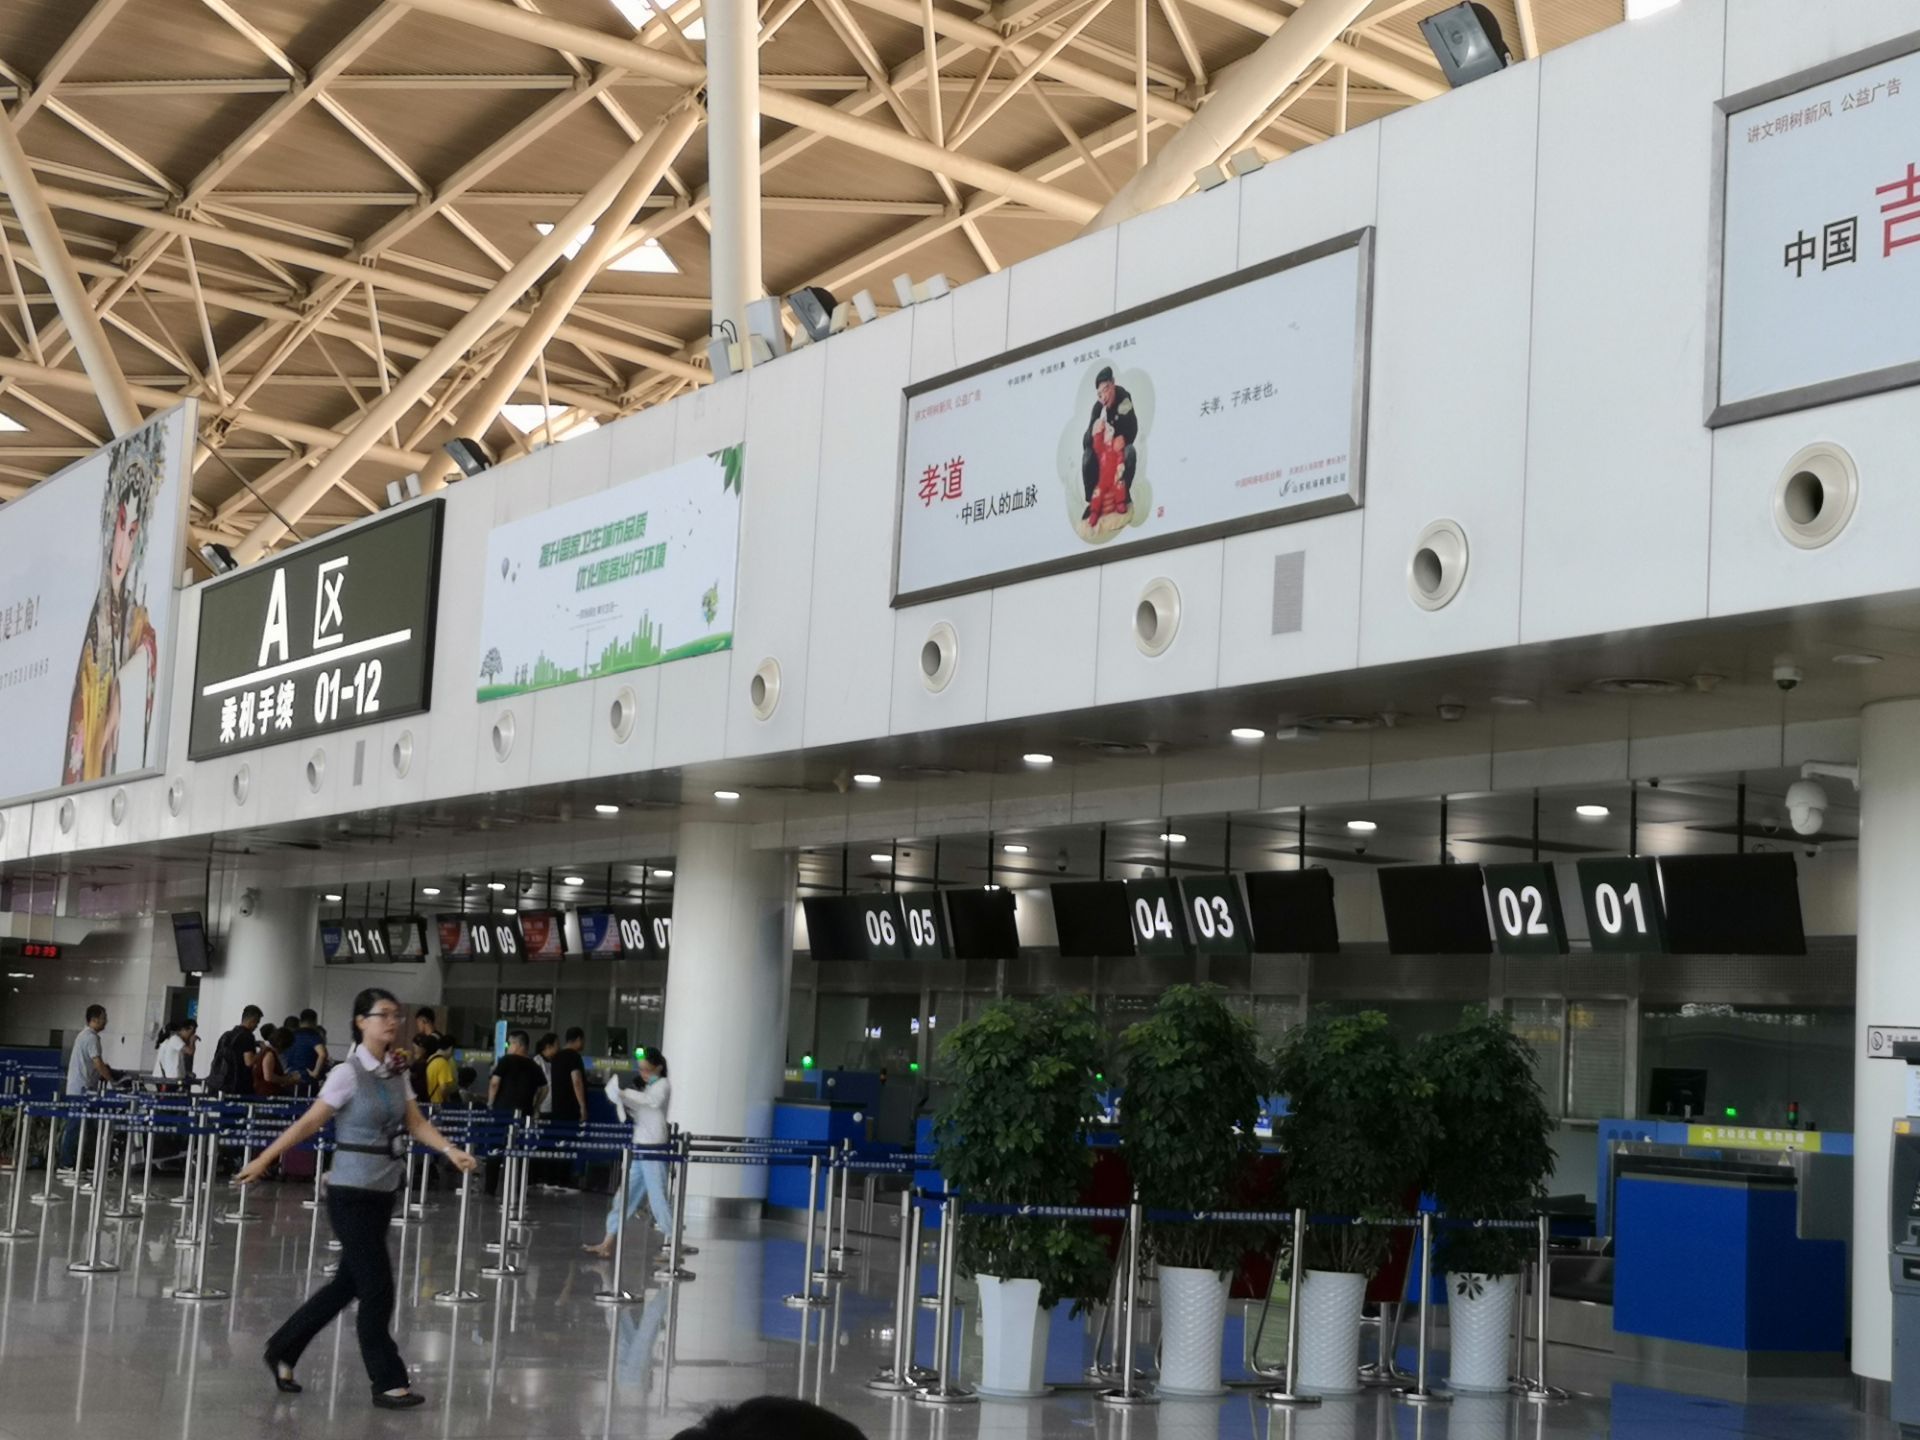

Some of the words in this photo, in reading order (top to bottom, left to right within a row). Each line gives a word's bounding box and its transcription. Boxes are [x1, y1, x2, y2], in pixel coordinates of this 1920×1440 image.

[1747, 100, 1832, 144] 讲文明树新风
[1840, 77, 1902, 113] 公益广告
[1783, 215, 1858, 279] 中国
[917, 455, 965, 508] 孝道
[575, 541, 667, 592] 优化旅客出行环境
[258, 567, 289, 668] A
[313, 556, 349, 650] 区
[219, 680, 295, 743] 乘机手续
[314, 659, 383, 724] 01-12
[865, 909, 896, 946] 06
[909, 908, 936, 946] 05
[1135, 896, 1172, 939] 04
[1194, 895, 1234, 938] 03
[1498, 886, 1549, 937] 02
[1595, 882, 1648, 933] 01
[348, 929, 366, 954] 12
[368, 929, 385, 954] 11
[471, 925, 490, 953] 10
[496, 925, 516, 954] 09
[620, 919, 645, 950] 08
